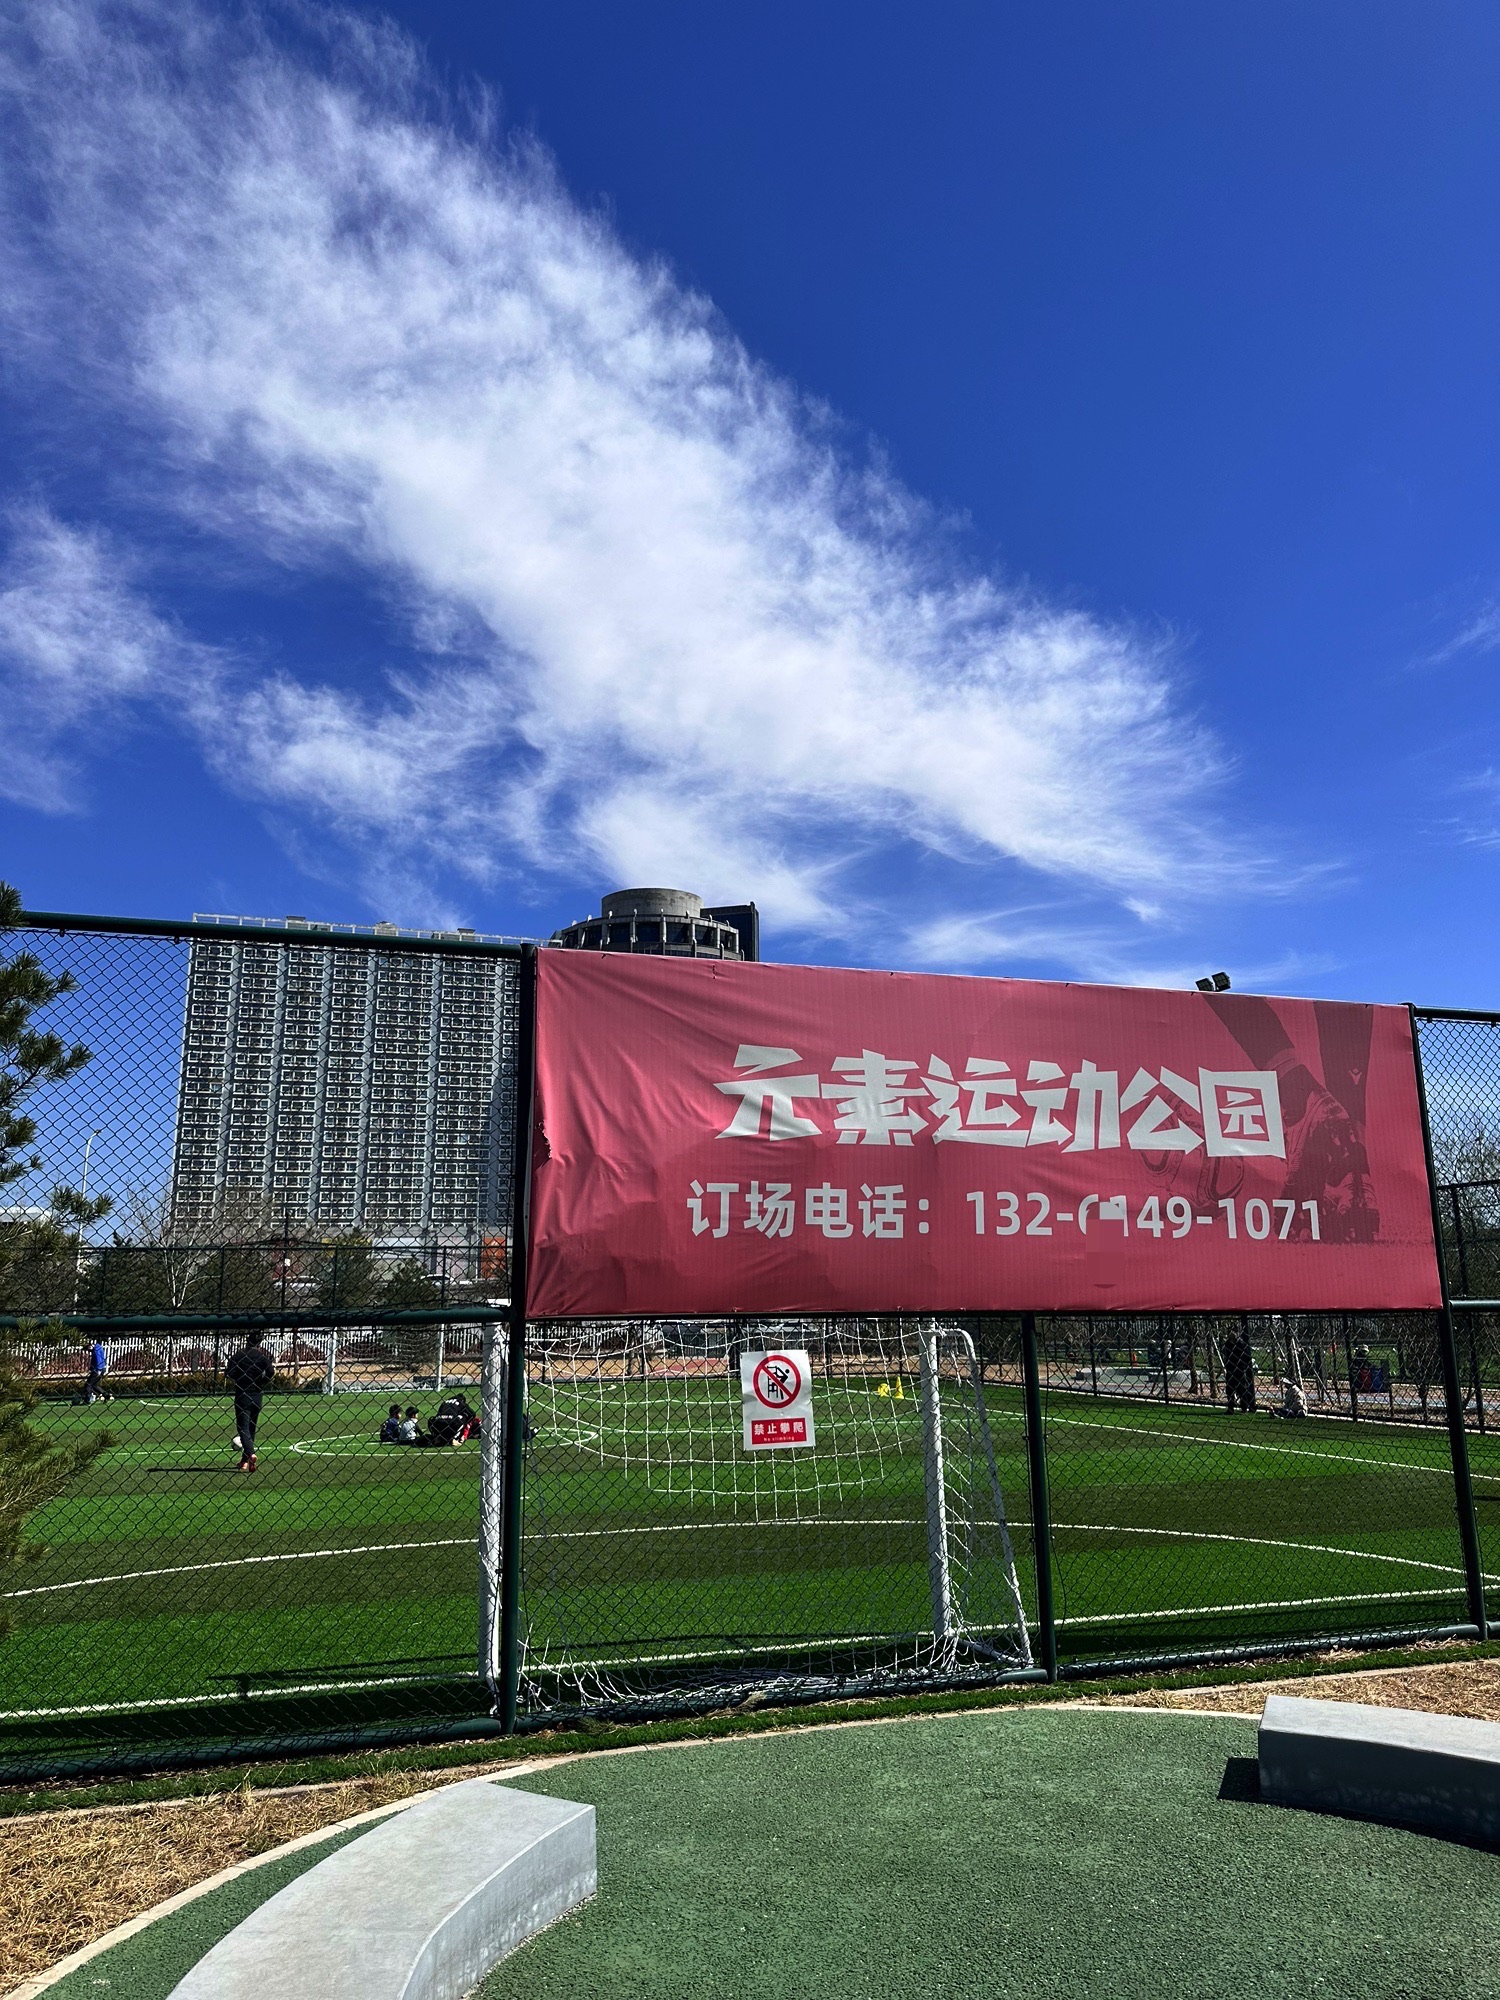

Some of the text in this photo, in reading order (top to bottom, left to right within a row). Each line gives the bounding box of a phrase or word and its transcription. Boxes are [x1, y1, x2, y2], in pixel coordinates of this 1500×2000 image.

[713, 1044, 1287, 1159] 元素运动公园
[686, 1179, 930, 1239] 订场电话：
[754, 1421, 804, 1436] 禁止攀爬
